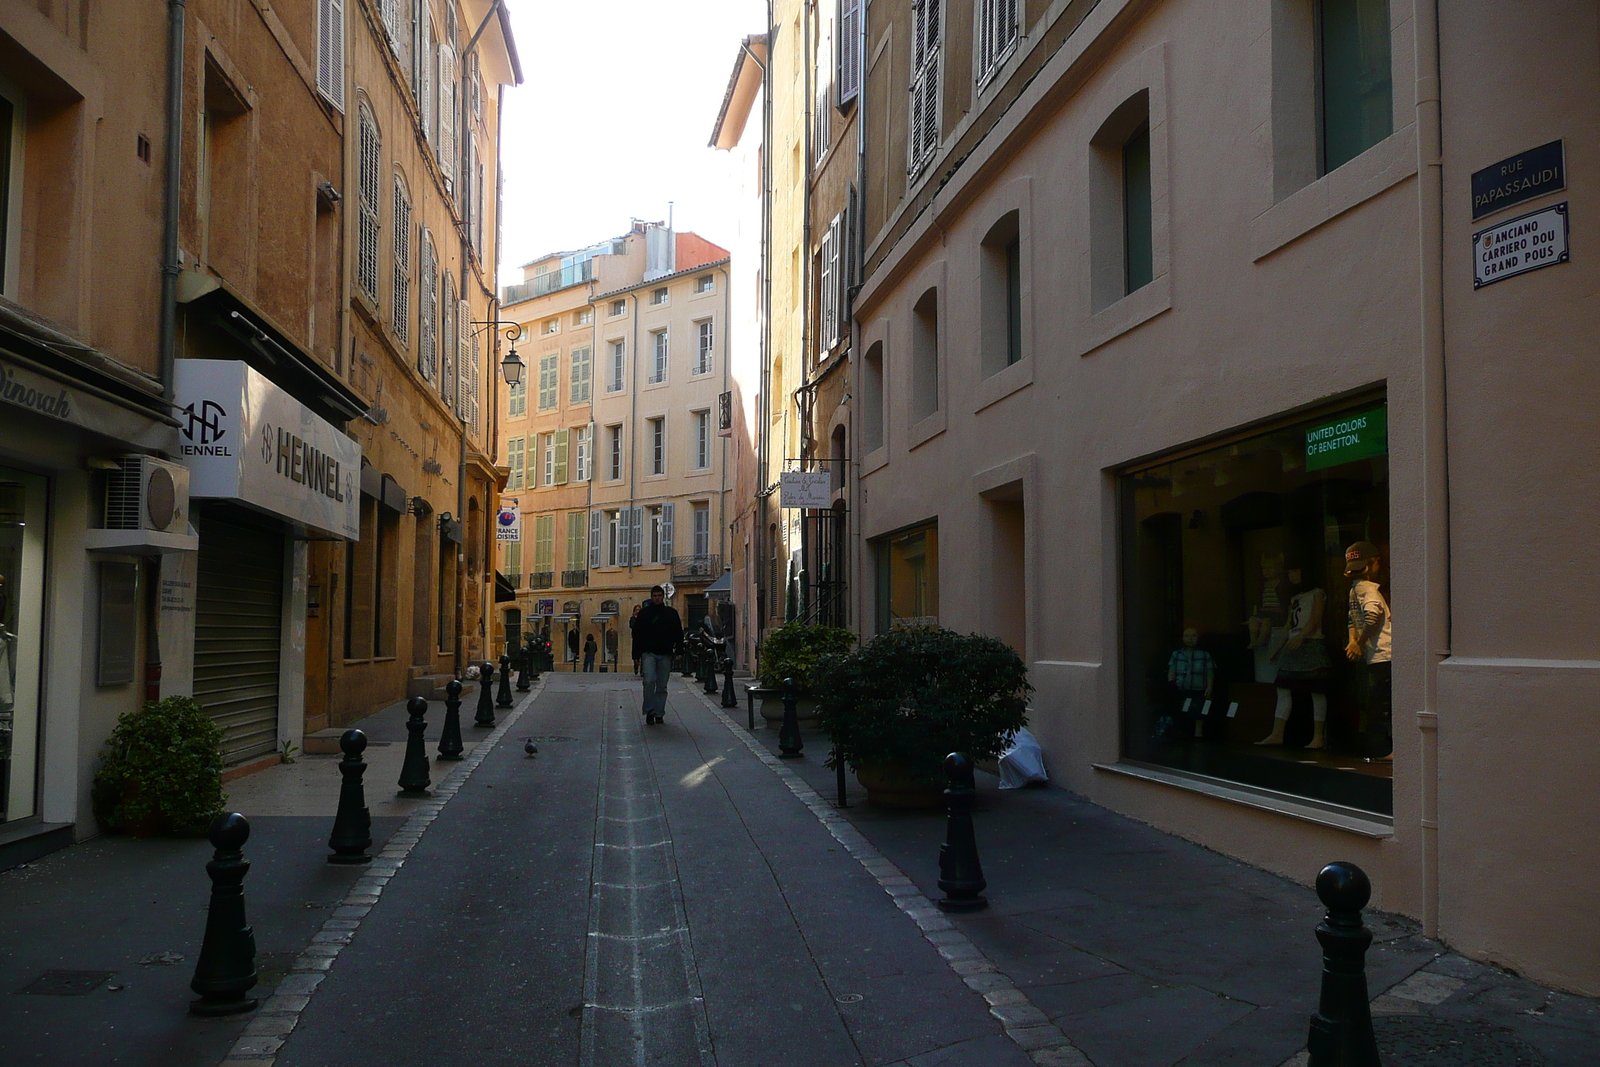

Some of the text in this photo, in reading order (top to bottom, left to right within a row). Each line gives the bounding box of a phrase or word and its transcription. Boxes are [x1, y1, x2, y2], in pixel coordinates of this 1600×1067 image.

[1501, 158, 1524, 177] RUE
[1475, 166, 1559, 208] PAPASSAUDI
[1482, 229, 1555, 263] CARRIERO DOU
[1495, 220, 1539, 245] ANCIANO
[1484, 245, 1554, 277] GRAND POUS
[1307, 416, 1367, 443] UNITED COLORS
[1307, 433, 1361, 456] OF BENETTON.
[276, 427, 344, 503] HENNEL
